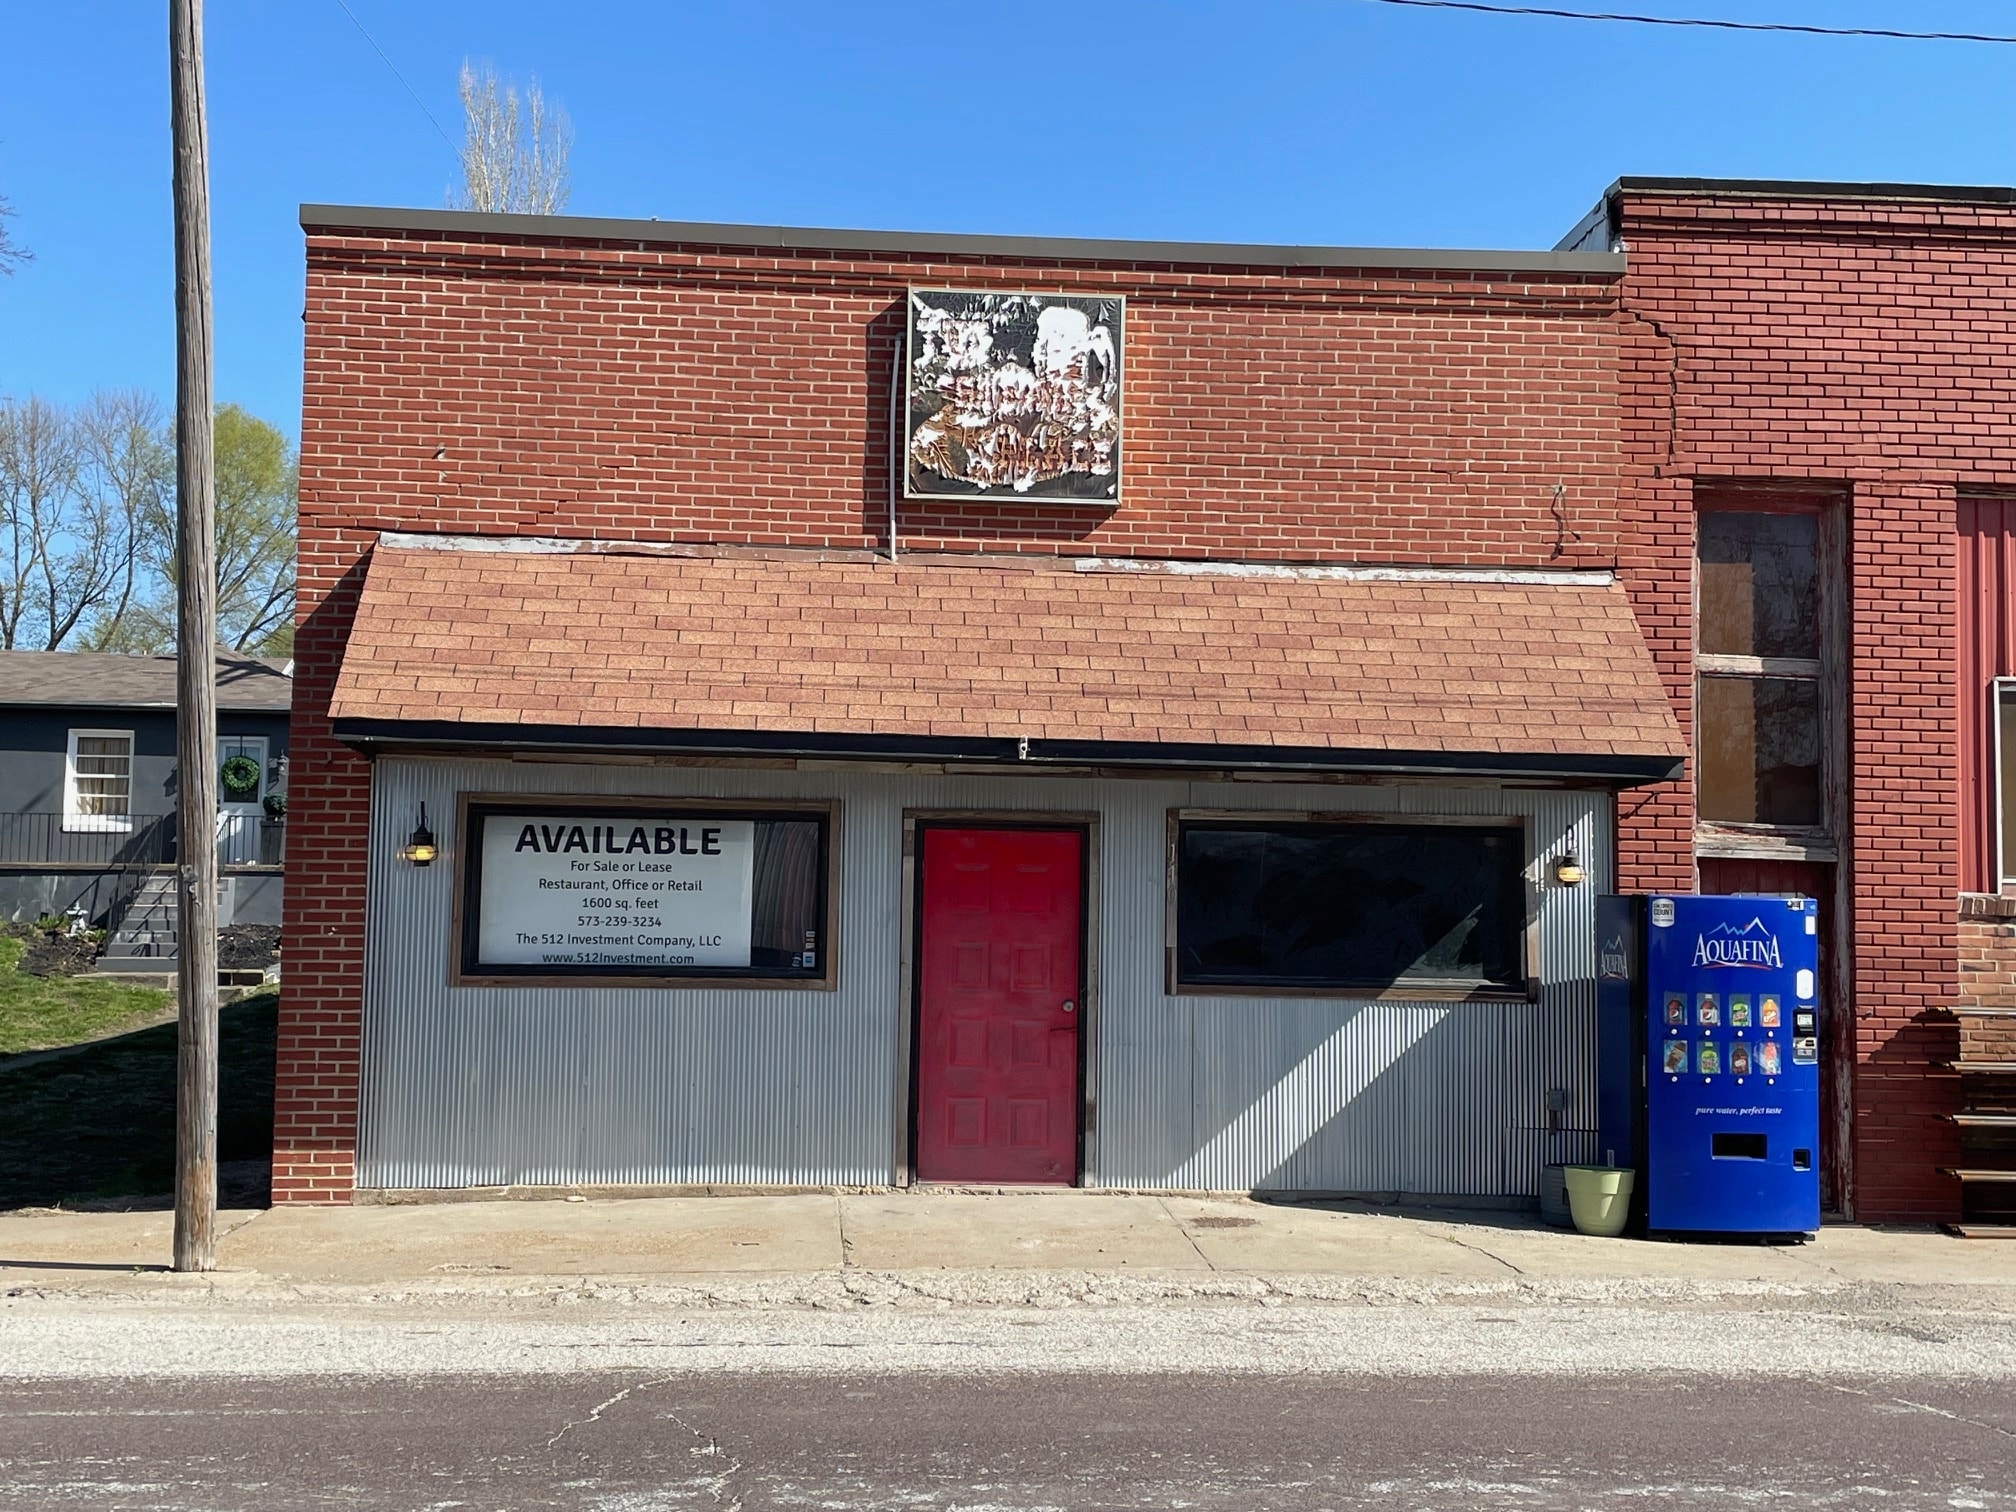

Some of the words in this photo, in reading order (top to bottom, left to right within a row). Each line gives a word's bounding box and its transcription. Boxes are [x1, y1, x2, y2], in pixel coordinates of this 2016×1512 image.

[515, 824, 722, 856] AVAILABLE
[570, 860, 591, 872] For
[593, 860, 619, 872] Sale
[622, 863, 636, 872] or
[638, 861, 673, 873] Lease
[538, 878, 609, 892] Restaurant,
[612, 879, 649, 891] Office
[652, 882, 665, 891] or
[668, 880, 703, 892] Retail
[582, 897, 612, 909] 1600
[615, 899, 632, 911] sq.
[635, 897, 659, 909] feet
[578, 915, 662, 927] 573-239-3234
[516, 933, 538, 945] The
[541, 933, 564, 945] 512
[567, 933, 634, 946] Investment
[637, 934, 695, 949] Company,
[699, 935, 721, 947] LLC
[1692, 932, 1783, 968] AQUAFINA
[542, 952, 695, 965] www.512Investment.com
[1695, 1107, 1714, 1115] pure
[1739, 1106, 1764, 1116] perfect
[1765, 1107, 1782, 1115] taste
